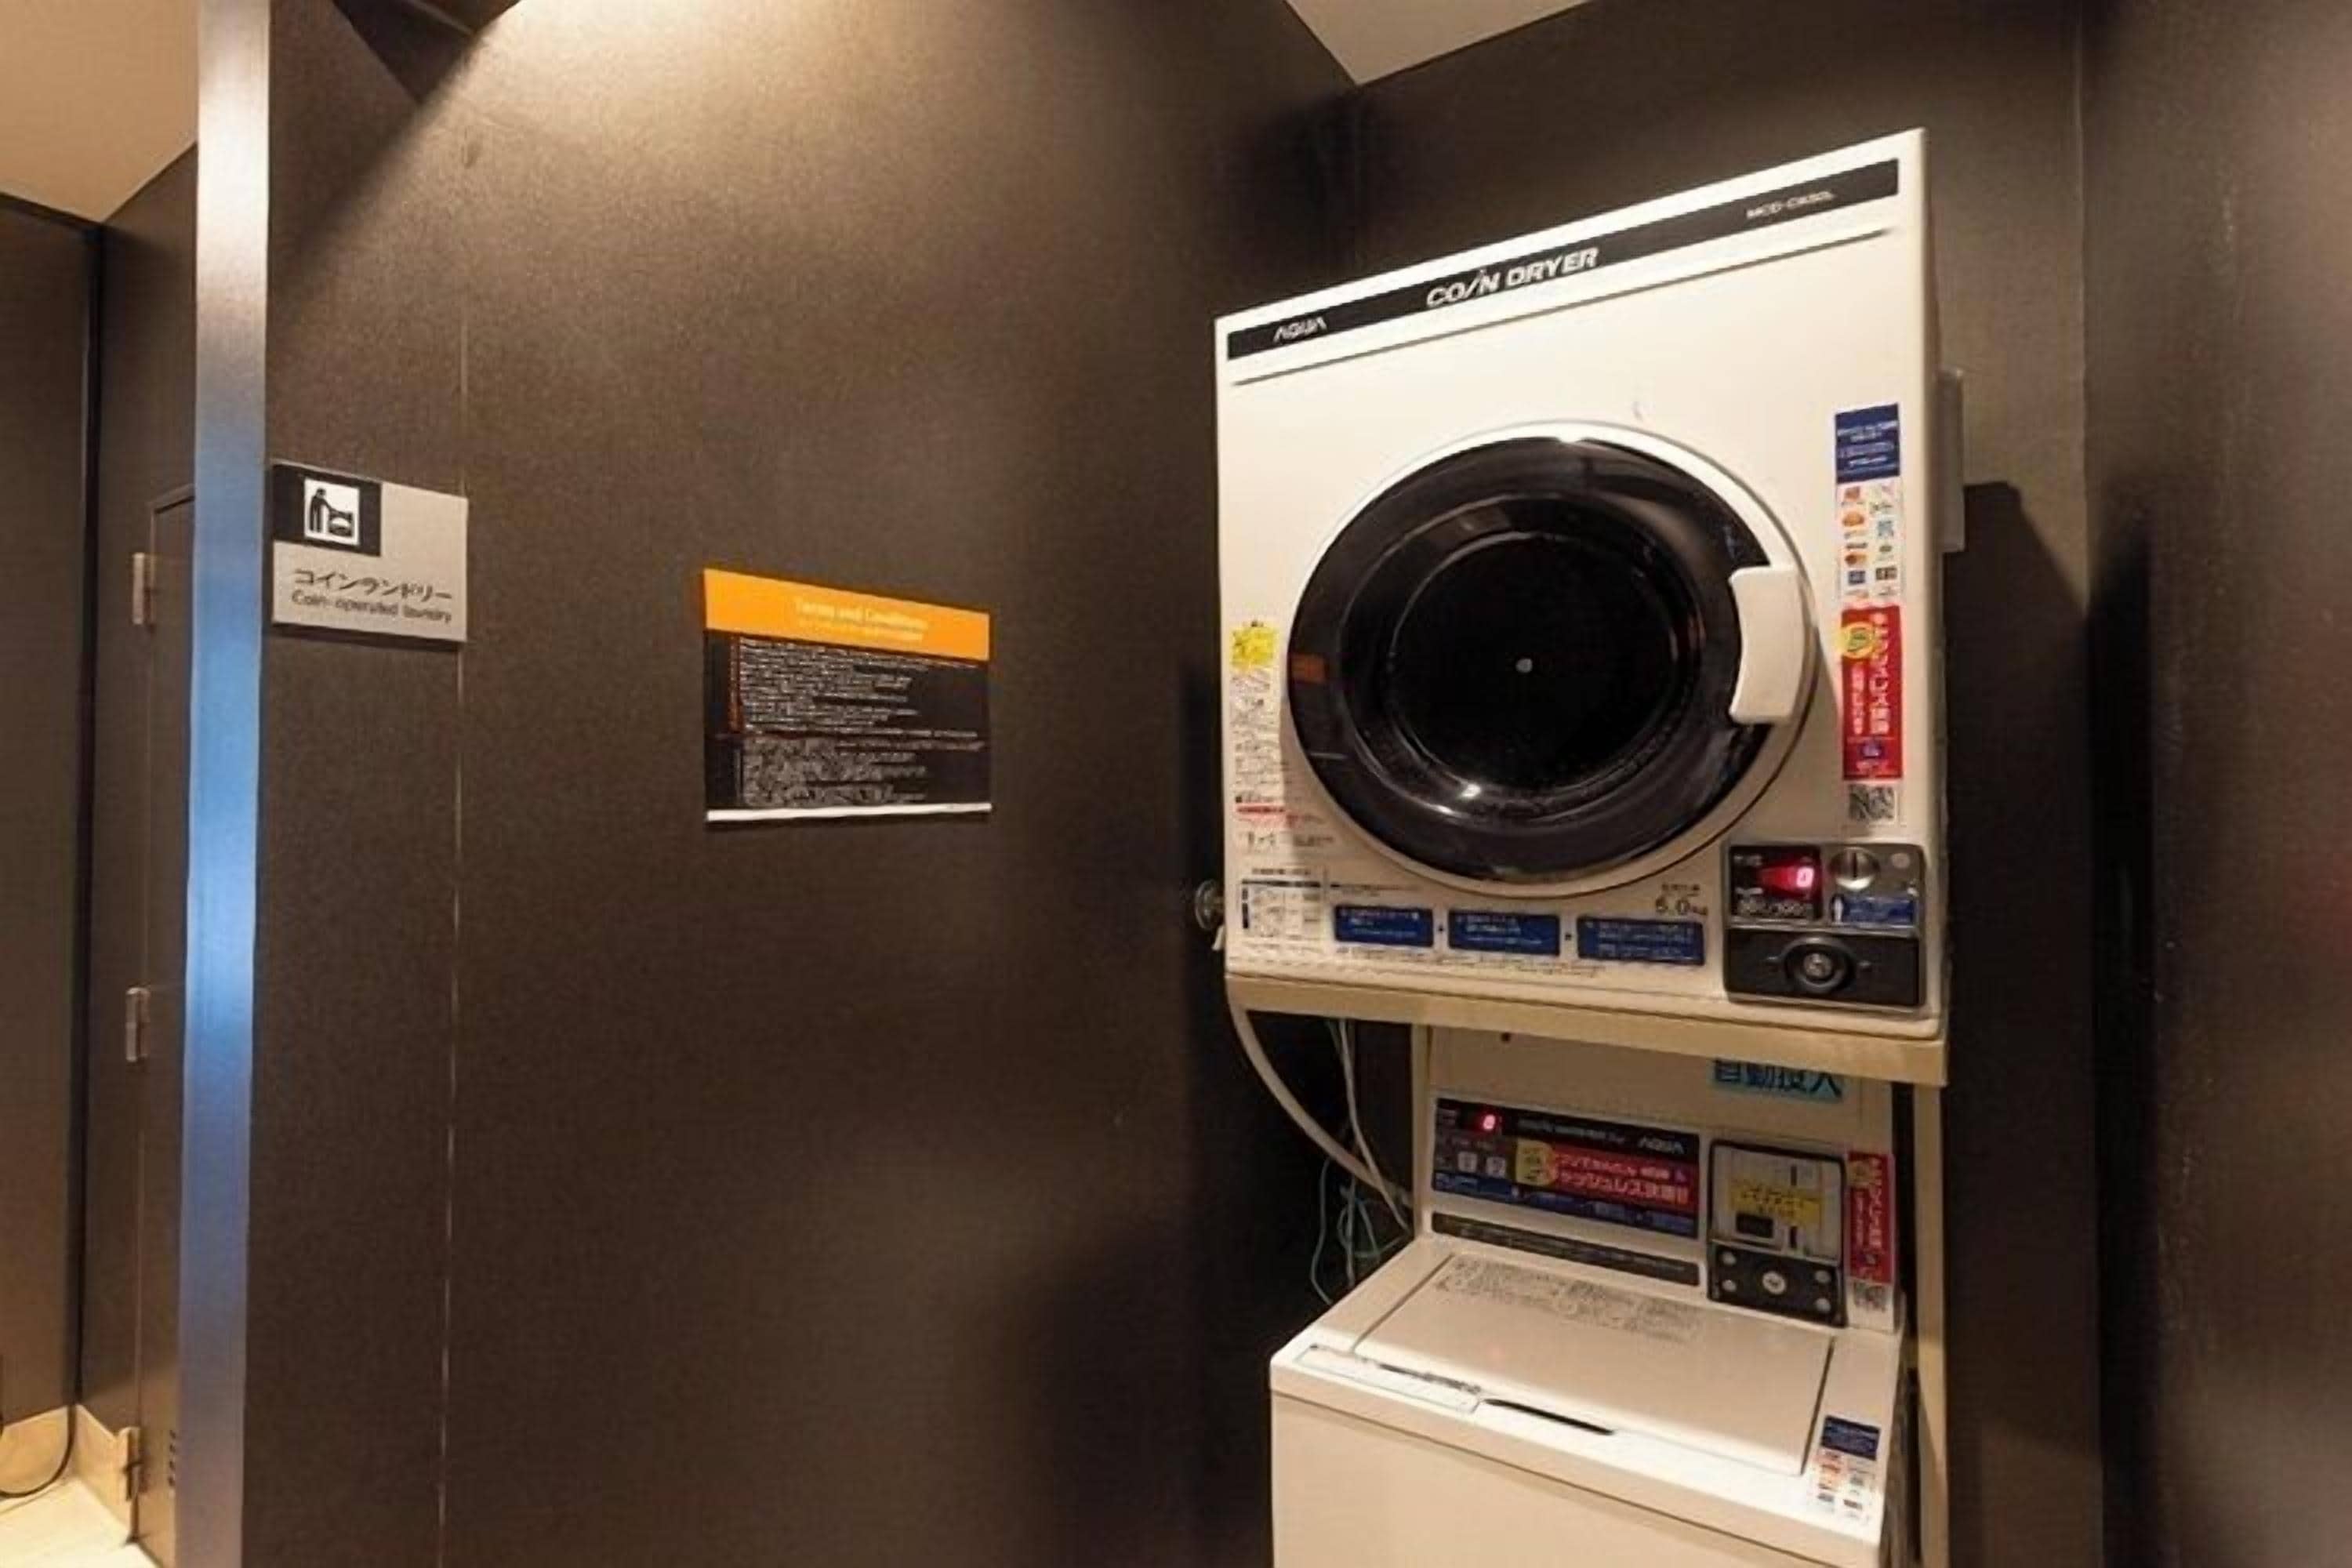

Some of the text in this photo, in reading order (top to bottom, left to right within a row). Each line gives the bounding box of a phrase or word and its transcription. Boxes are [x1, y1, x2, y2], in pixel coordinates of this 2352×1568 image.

[1426, 247, 1599, 307] COIN DRYER
[1272, 316, 1328, 343] AQUA
[293, 568, 452, 602] コインランドリー
